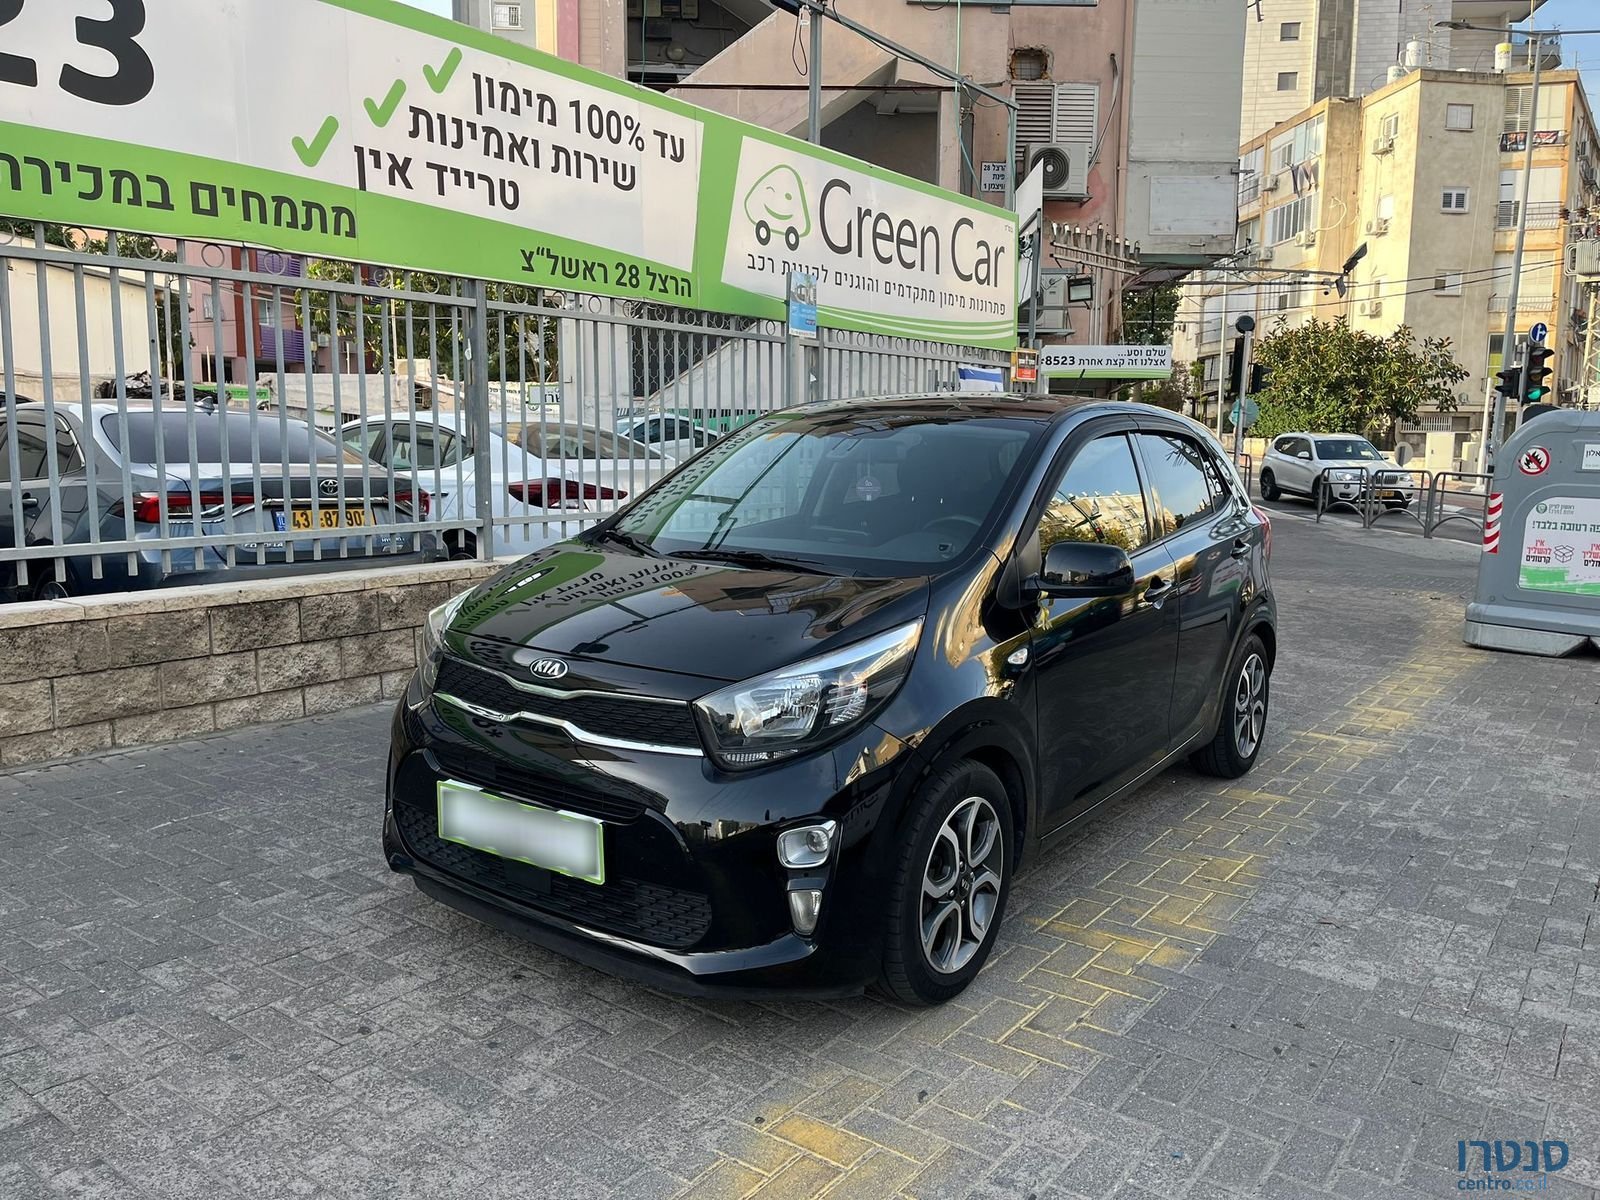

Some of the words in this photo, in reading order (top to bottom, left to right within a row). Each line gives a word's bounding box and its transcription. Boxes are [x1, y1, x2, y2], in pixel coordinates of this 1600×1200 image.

[472, 72, 557, 126] מימון
[408, 105, 540, 169] ואמינות
[569, 100, 645, 152] 100%
[653, 129, 685, 163] עד
[354, 145, 414, 191] אין
[551, 144, 636, 191] שירות
[426, 161, 520, 211] טרייד
[189, 180, 357, 239] מתמחים
[819, 178, 940, 275] Green
[950, 217, 1005, 288] Car
[747, 253, 775, 273] רכב
[615, 262, 640, 289] 28
[645, 266, 692, 298] הרצל
[835, 271, 879, 293] והוגנים
[884, 281, 935, 304] מתקדמים
[939, 291, 966, 309] מימון
[969, 297, 1006, 315] פתרונות
[1078, 358, 1103, 366] אחרת
[1105, 358, 1125, 368] קצת
[1127, 358, 1138, 366] זה
[1140, 357, 1166, 366] אצלנו
[1145, 348, 1166, 357] שלם
[1532, 520, 1557, 530] בלבד!
[1560, 522, 1587, 532] רטובה
[1527, 547, 1552, 555] להשליך
[533, 660, 561, 676] KIA
